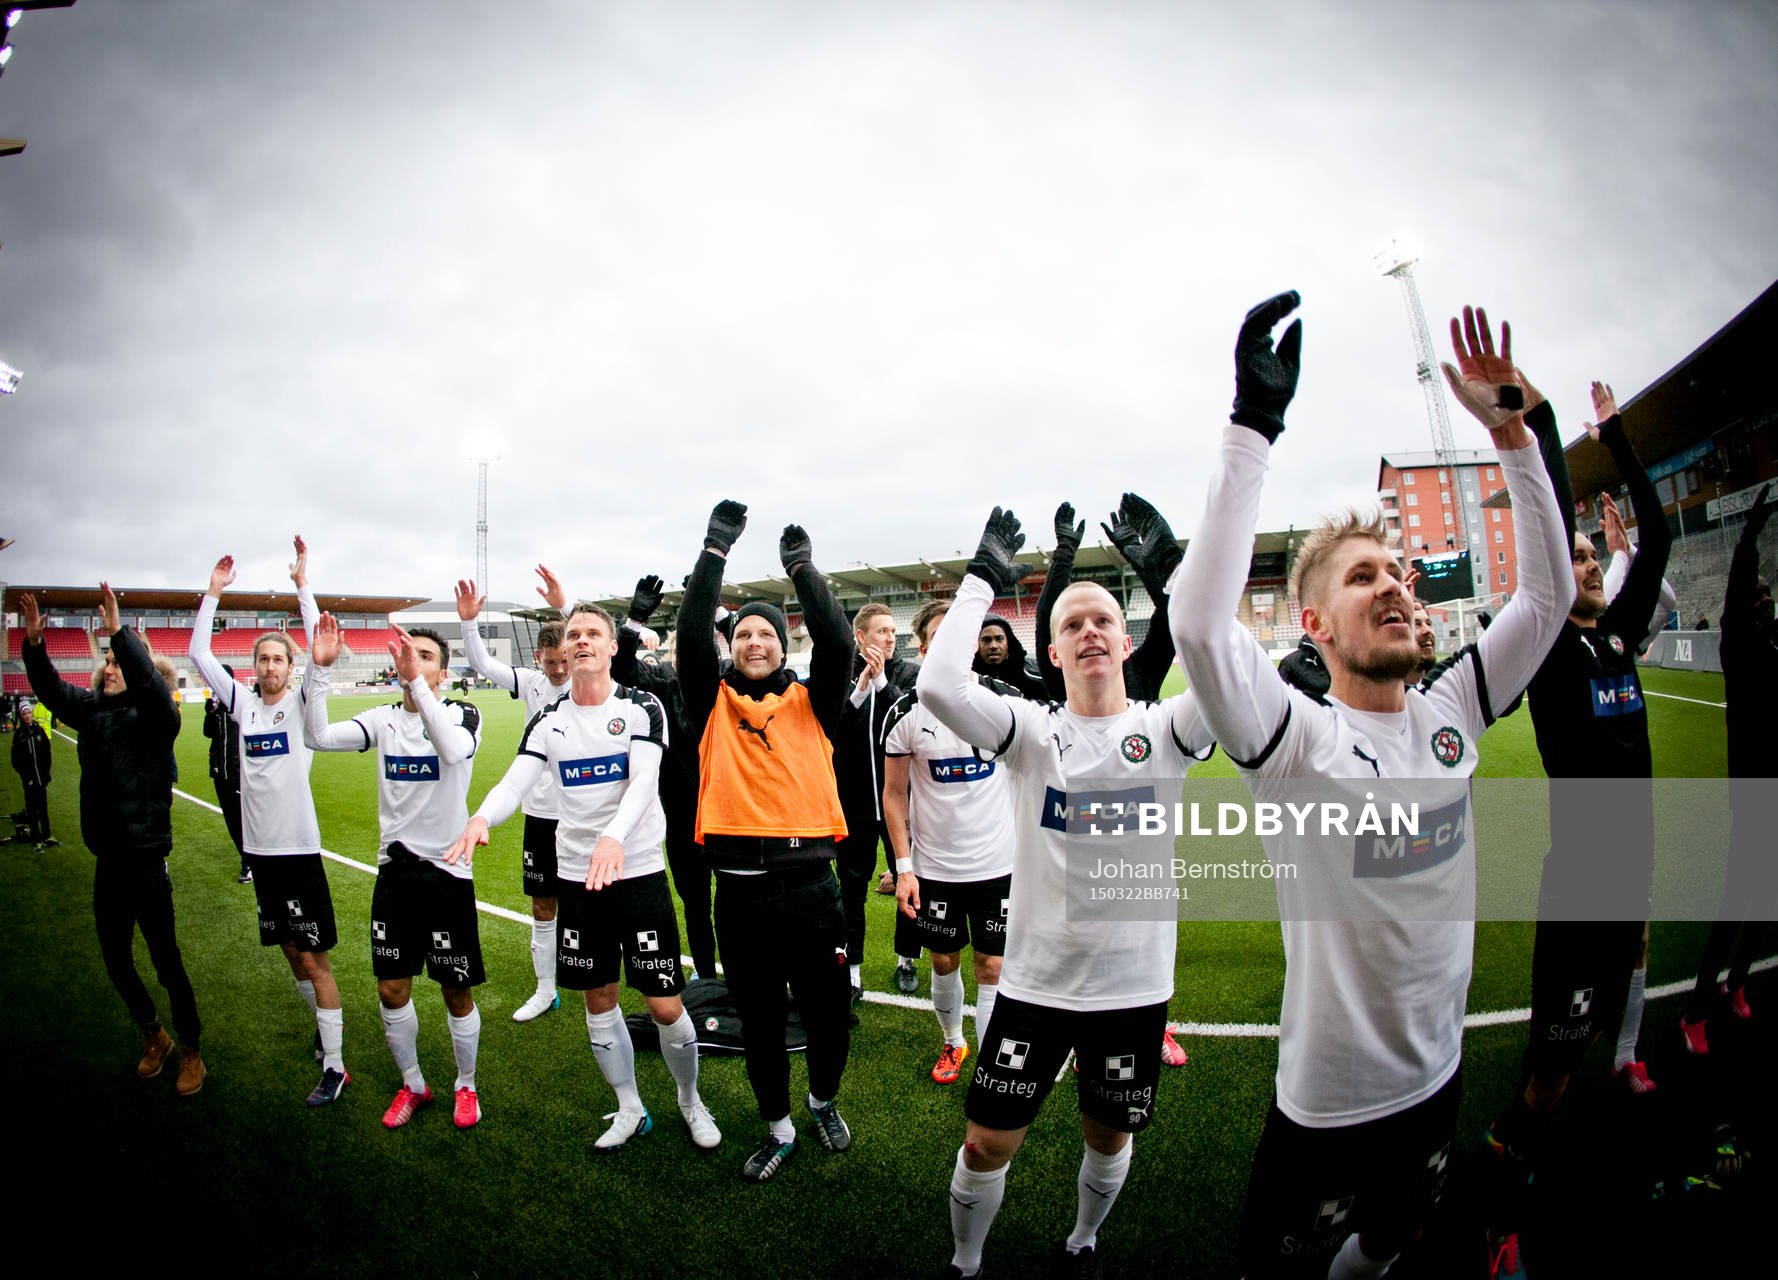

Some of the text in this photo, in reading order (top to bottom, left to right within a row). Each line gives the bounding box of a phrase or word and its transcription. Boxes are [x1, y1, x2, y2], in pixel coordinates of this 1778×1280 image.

[1674, 639, 1692, 662] NA
[1598, 685, 1635, 704] MEC
[565, 762, 623, 779] MECA
[935, 763, 990, 776] MECA
[790, 837, 800, 848] 21
[632, 955, 674, 971] Strateg
[975, 1066, 1037, 1098] Strateg
